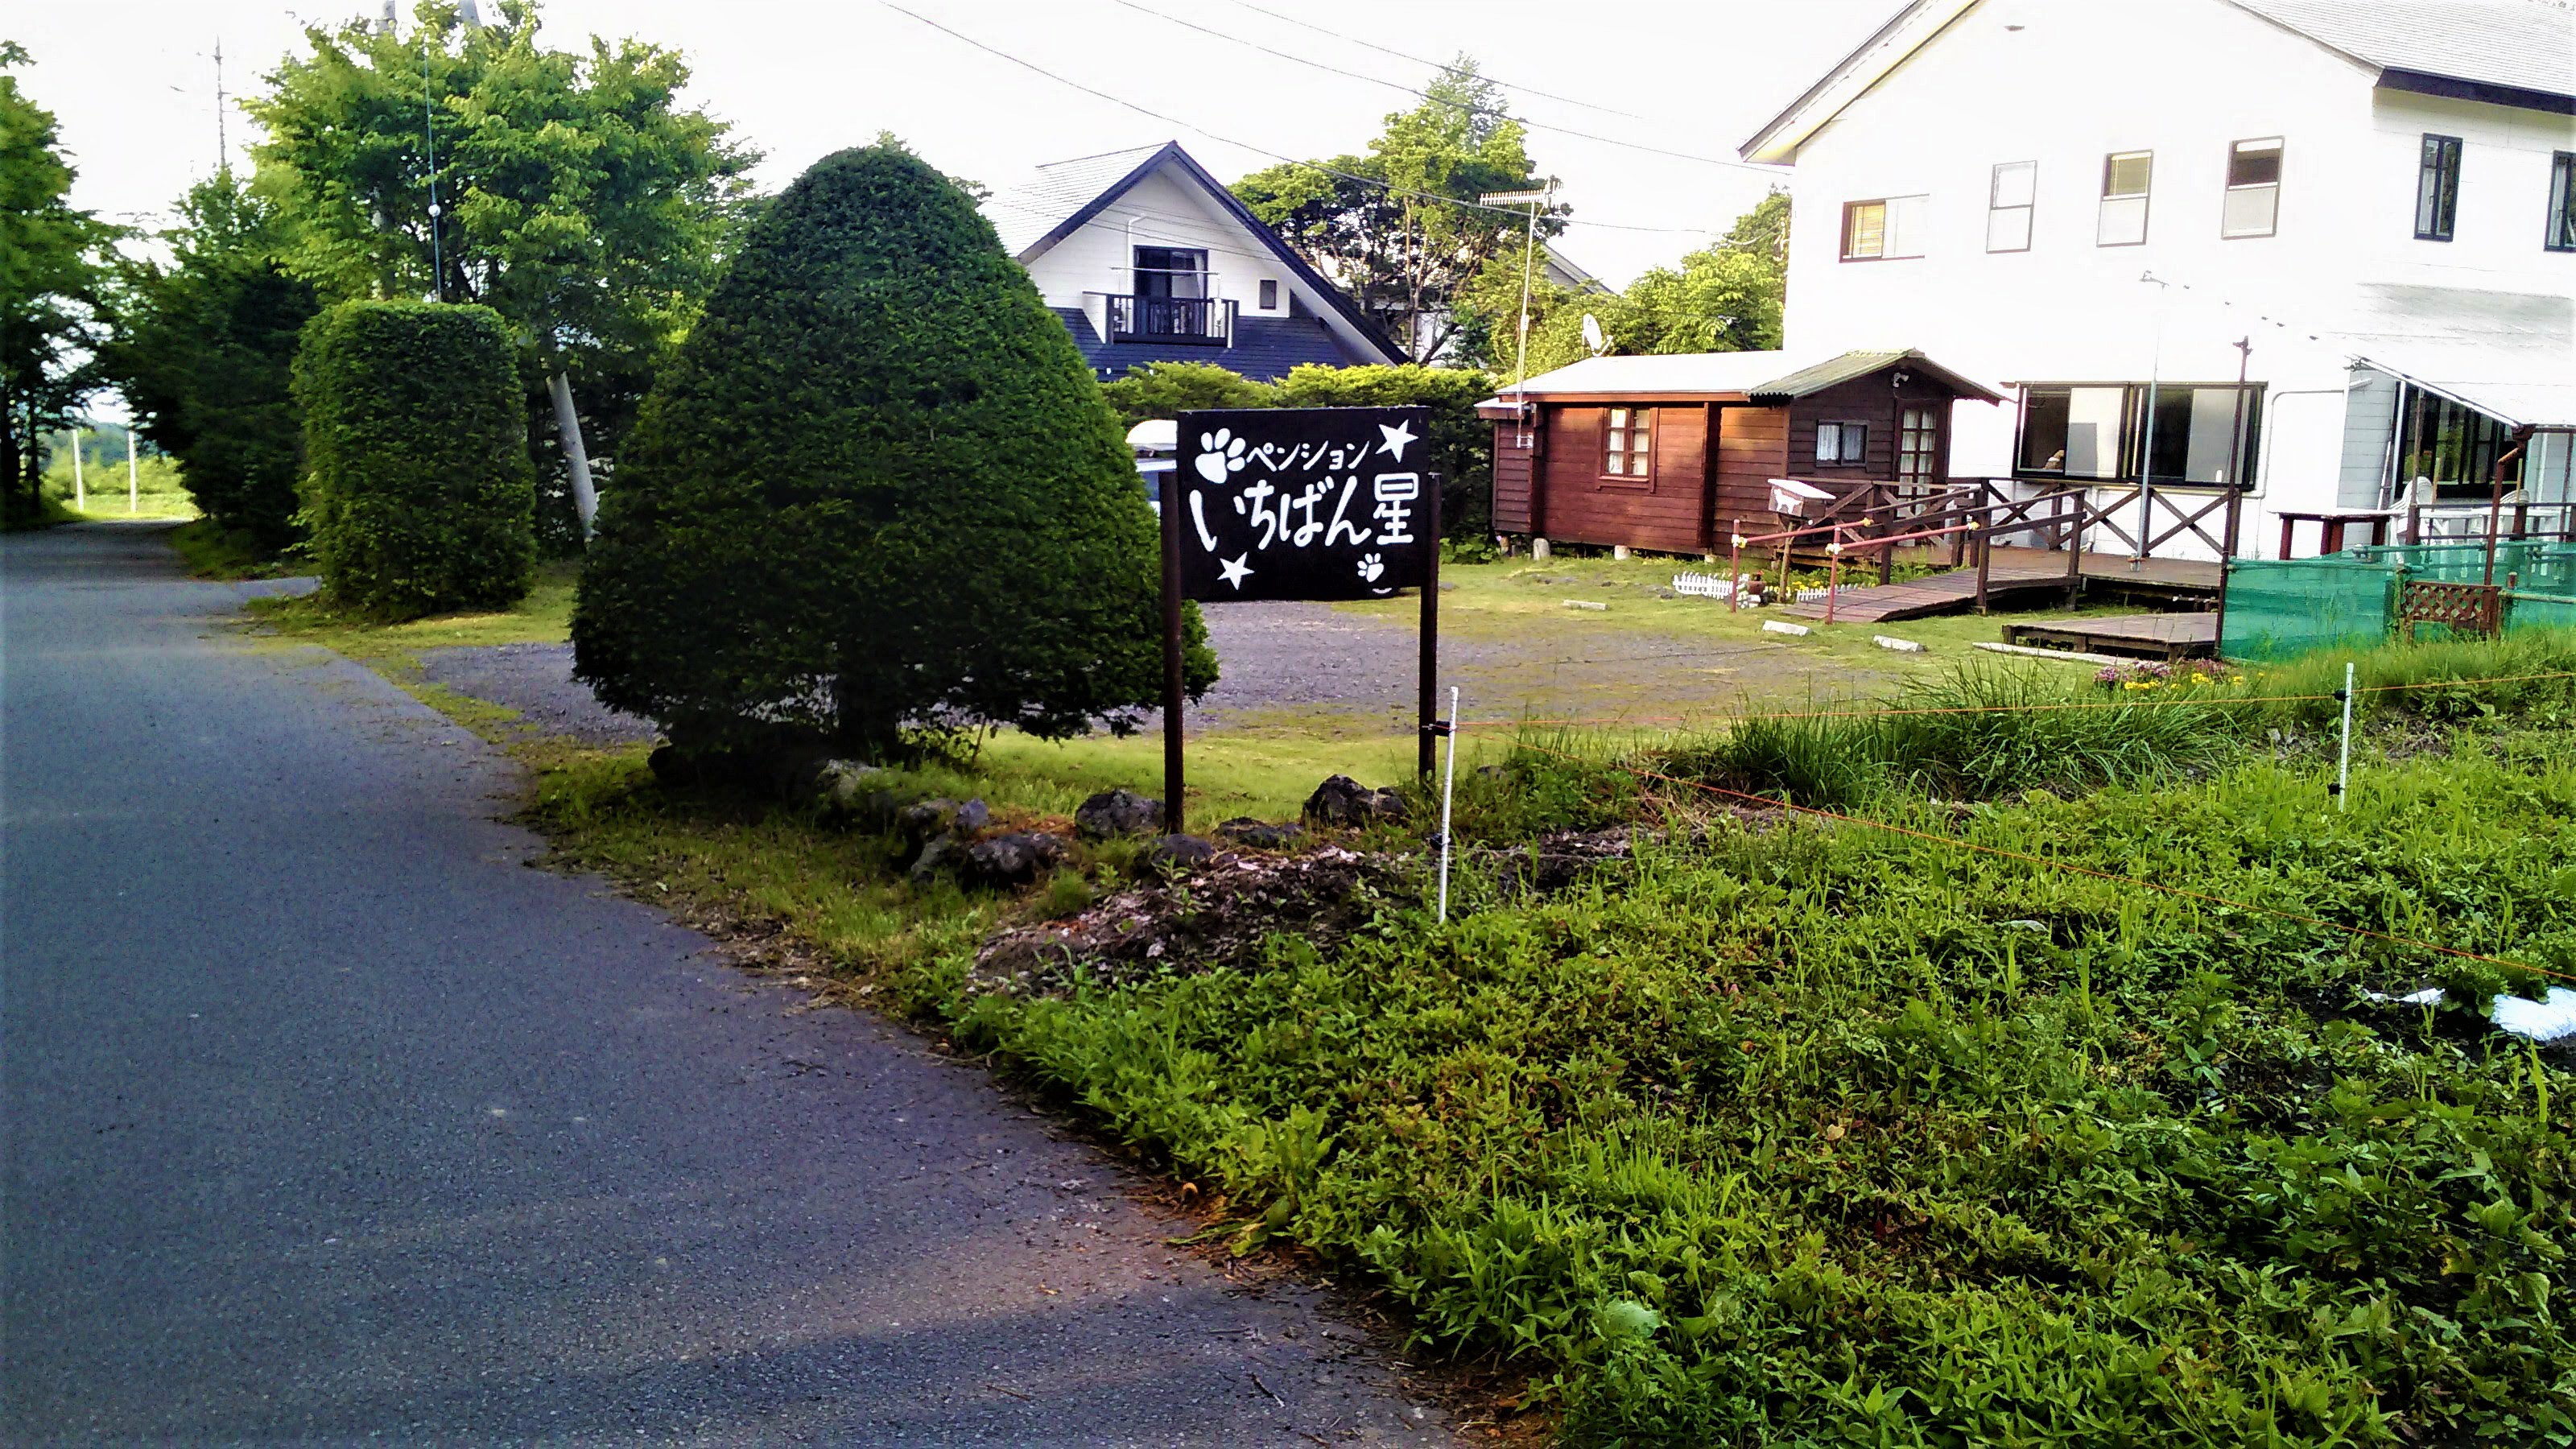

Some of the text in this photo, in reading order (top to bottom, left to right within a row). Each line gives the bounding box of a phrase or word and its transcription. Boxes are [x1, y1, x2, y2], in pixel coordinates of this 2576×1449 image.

[1247, 440, 1370, 472] ペンション
[1189, 473, 1419, 552] いちばん星
